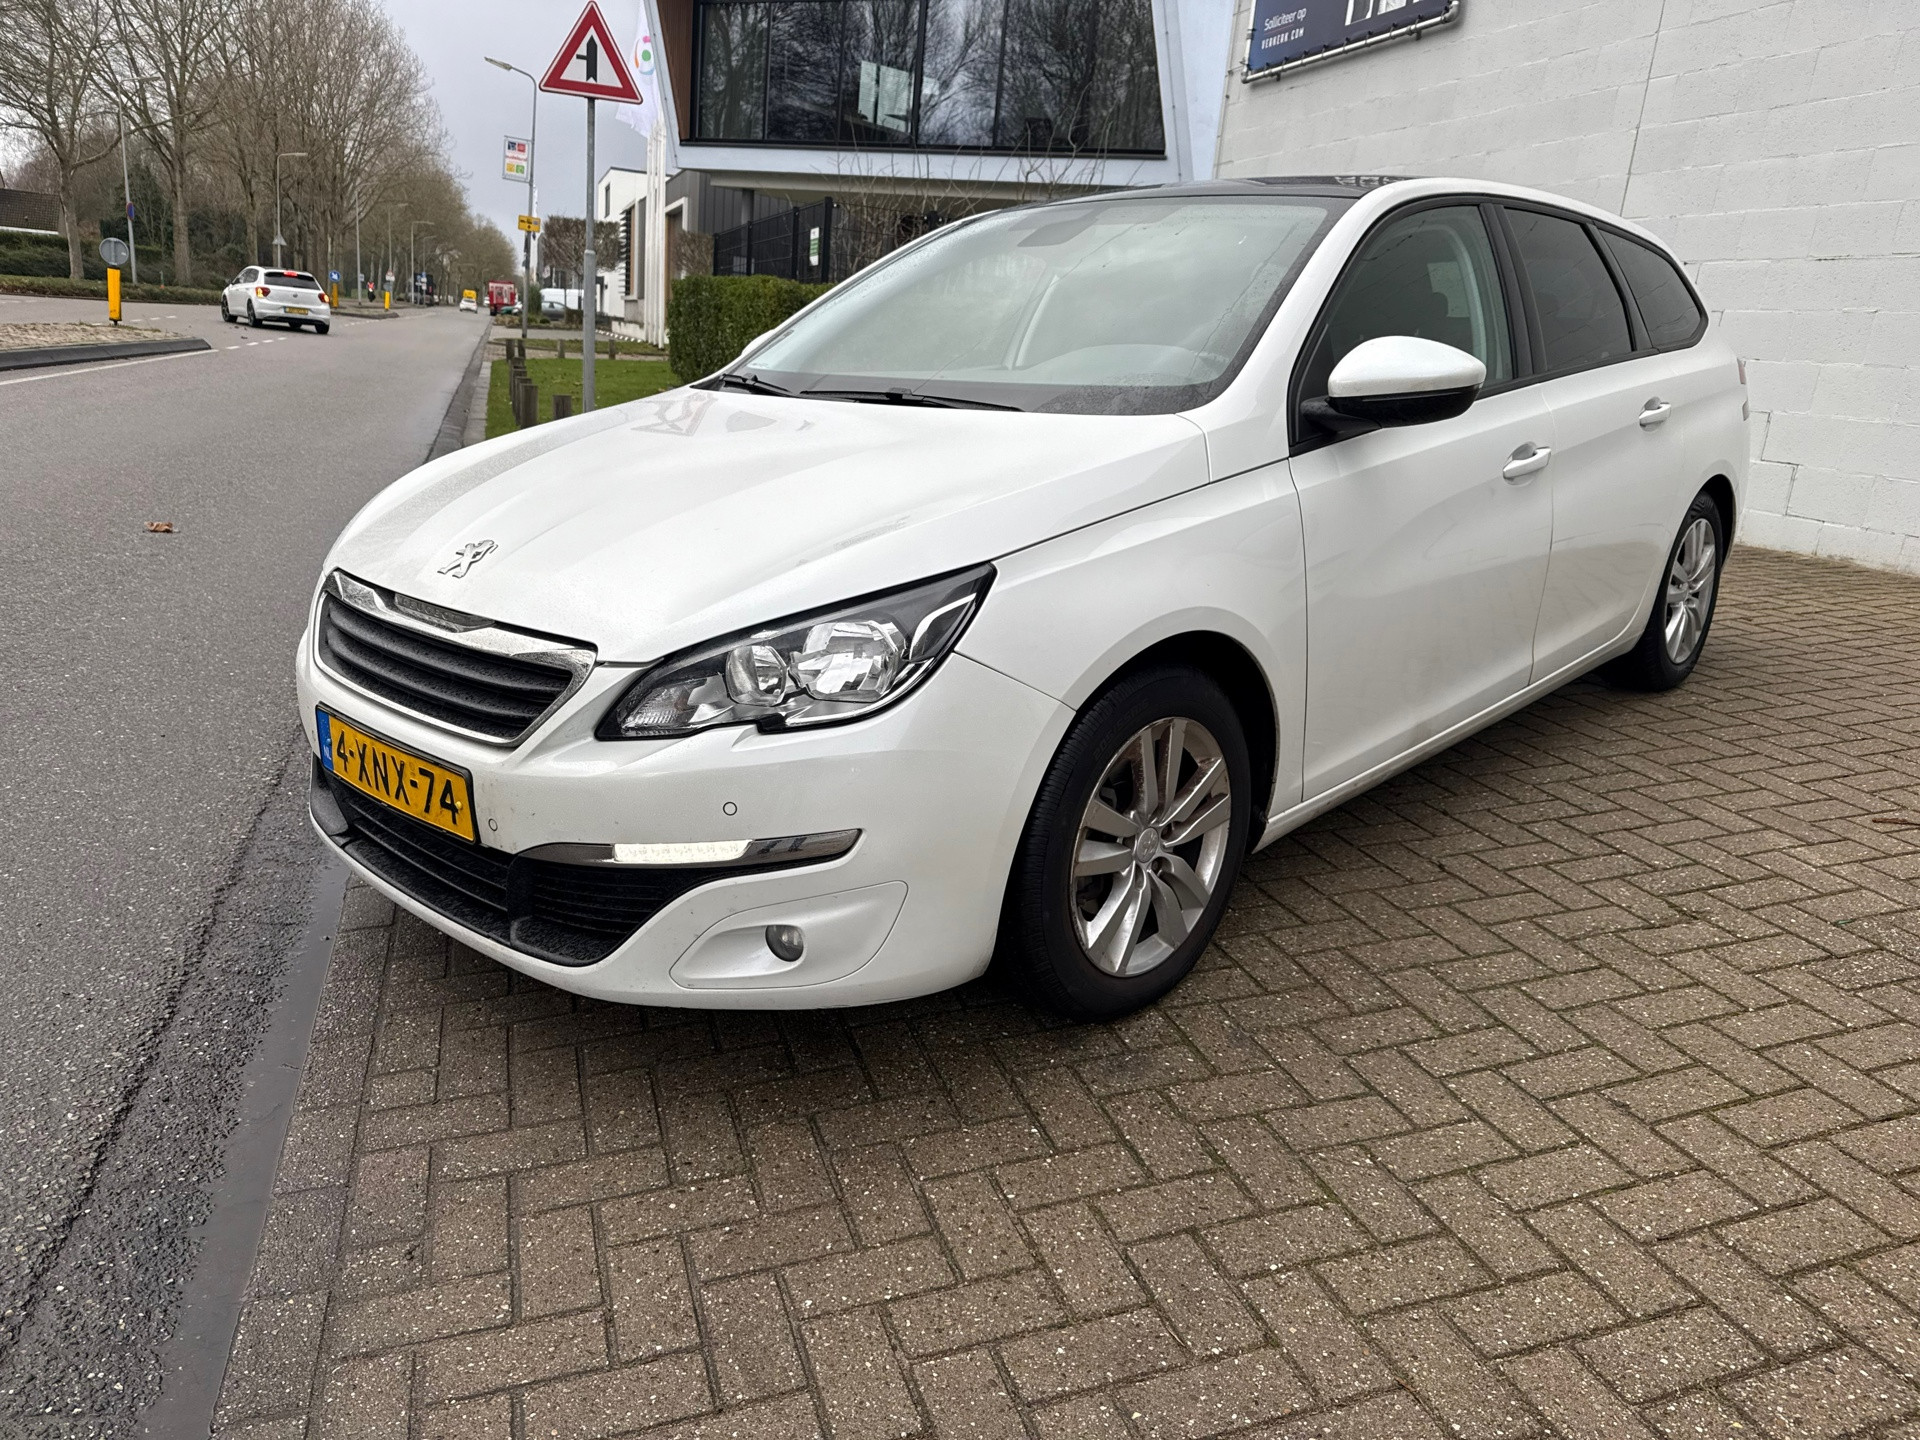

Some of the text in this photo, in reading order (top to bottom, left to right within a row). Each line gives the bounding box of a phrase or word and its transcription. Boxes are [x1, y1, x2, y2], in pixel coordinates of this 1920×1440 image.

[1264, 8, 1307, 31] Solliciteer op
[323, 744, 332, 761] NL
[336, 730, 459, 825] 4-XNX-74
